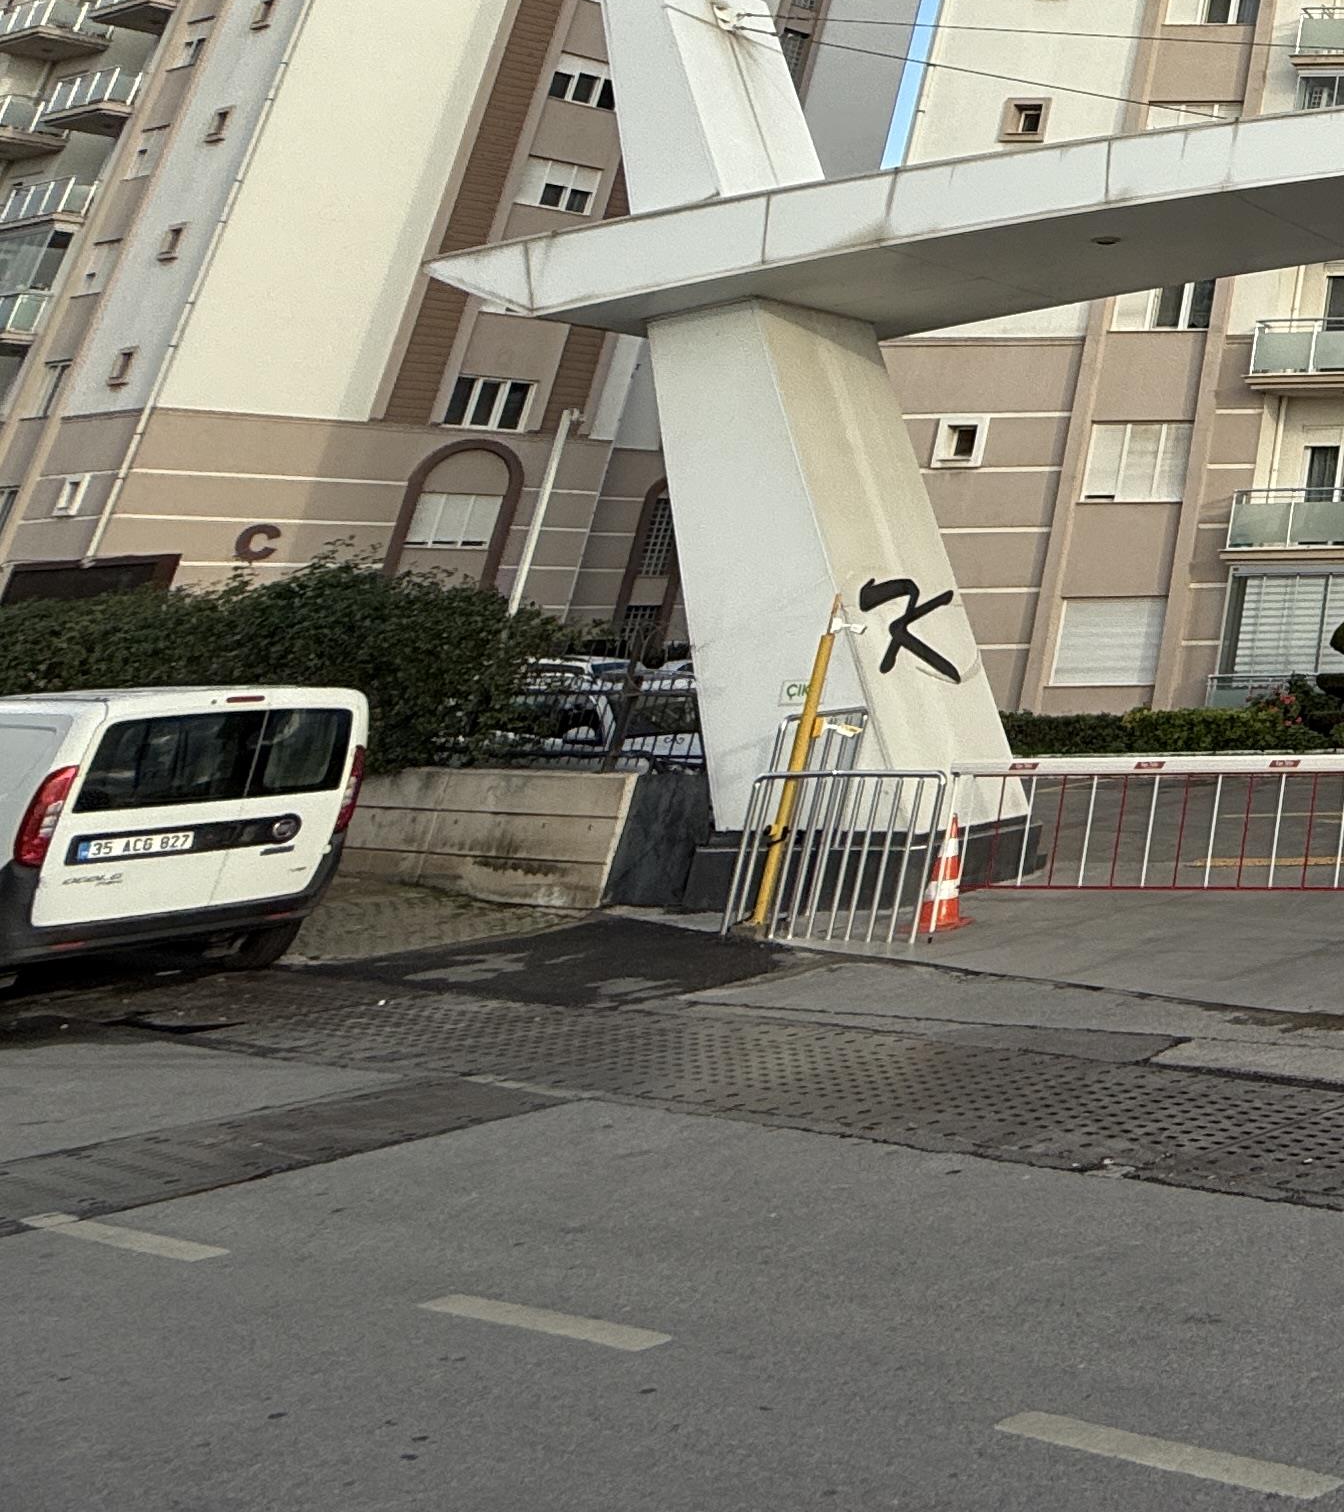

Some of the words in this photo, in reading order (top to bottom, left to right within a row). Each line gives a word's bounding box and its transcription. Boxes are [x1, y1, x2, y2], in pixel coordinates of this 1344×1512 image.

[234, 524, 282, 562] C
[91, 841, 113, 856] 35
[123, 837, 153, 853] ACG
[160, 834, 190, 850] 827
